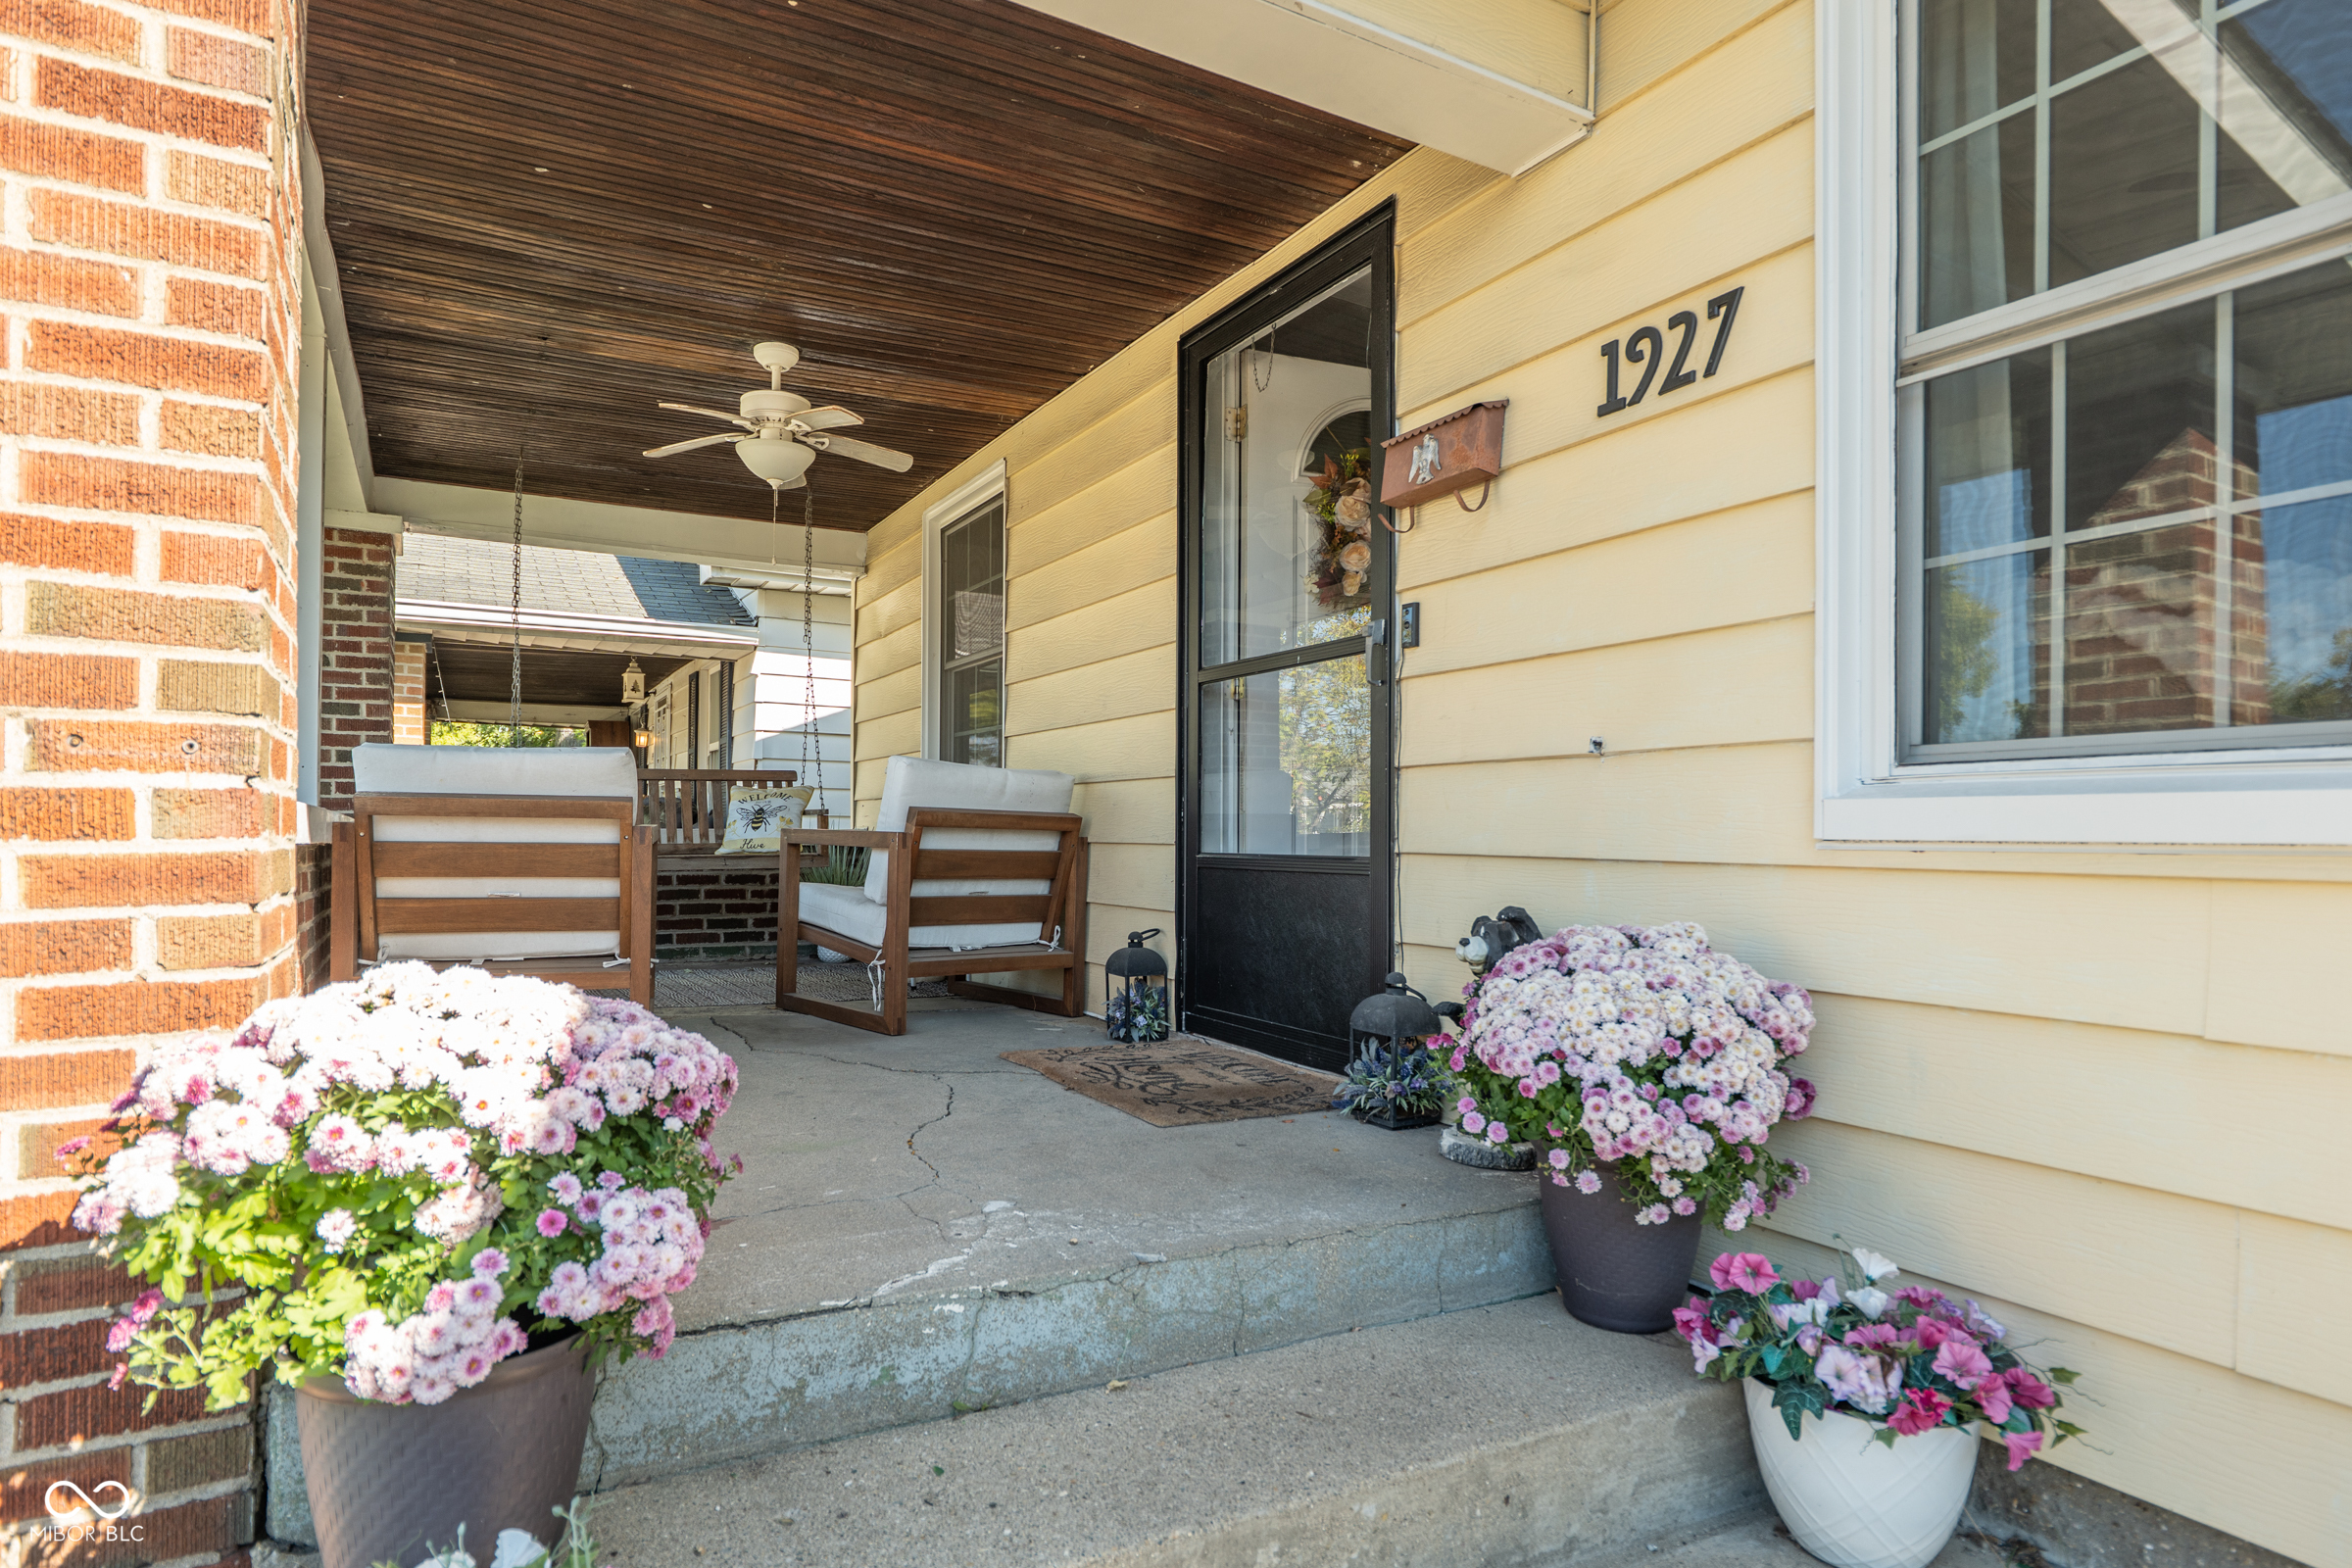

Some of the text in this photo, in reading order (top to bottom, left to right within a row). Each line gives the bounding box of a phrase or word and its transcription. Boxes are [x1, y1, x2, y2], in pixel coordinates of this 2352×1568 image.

[1597, 286, 1745, 417] 1927
[738, 792, 794, 805] WELCOME
[741, 839, 765, 850] Hive
